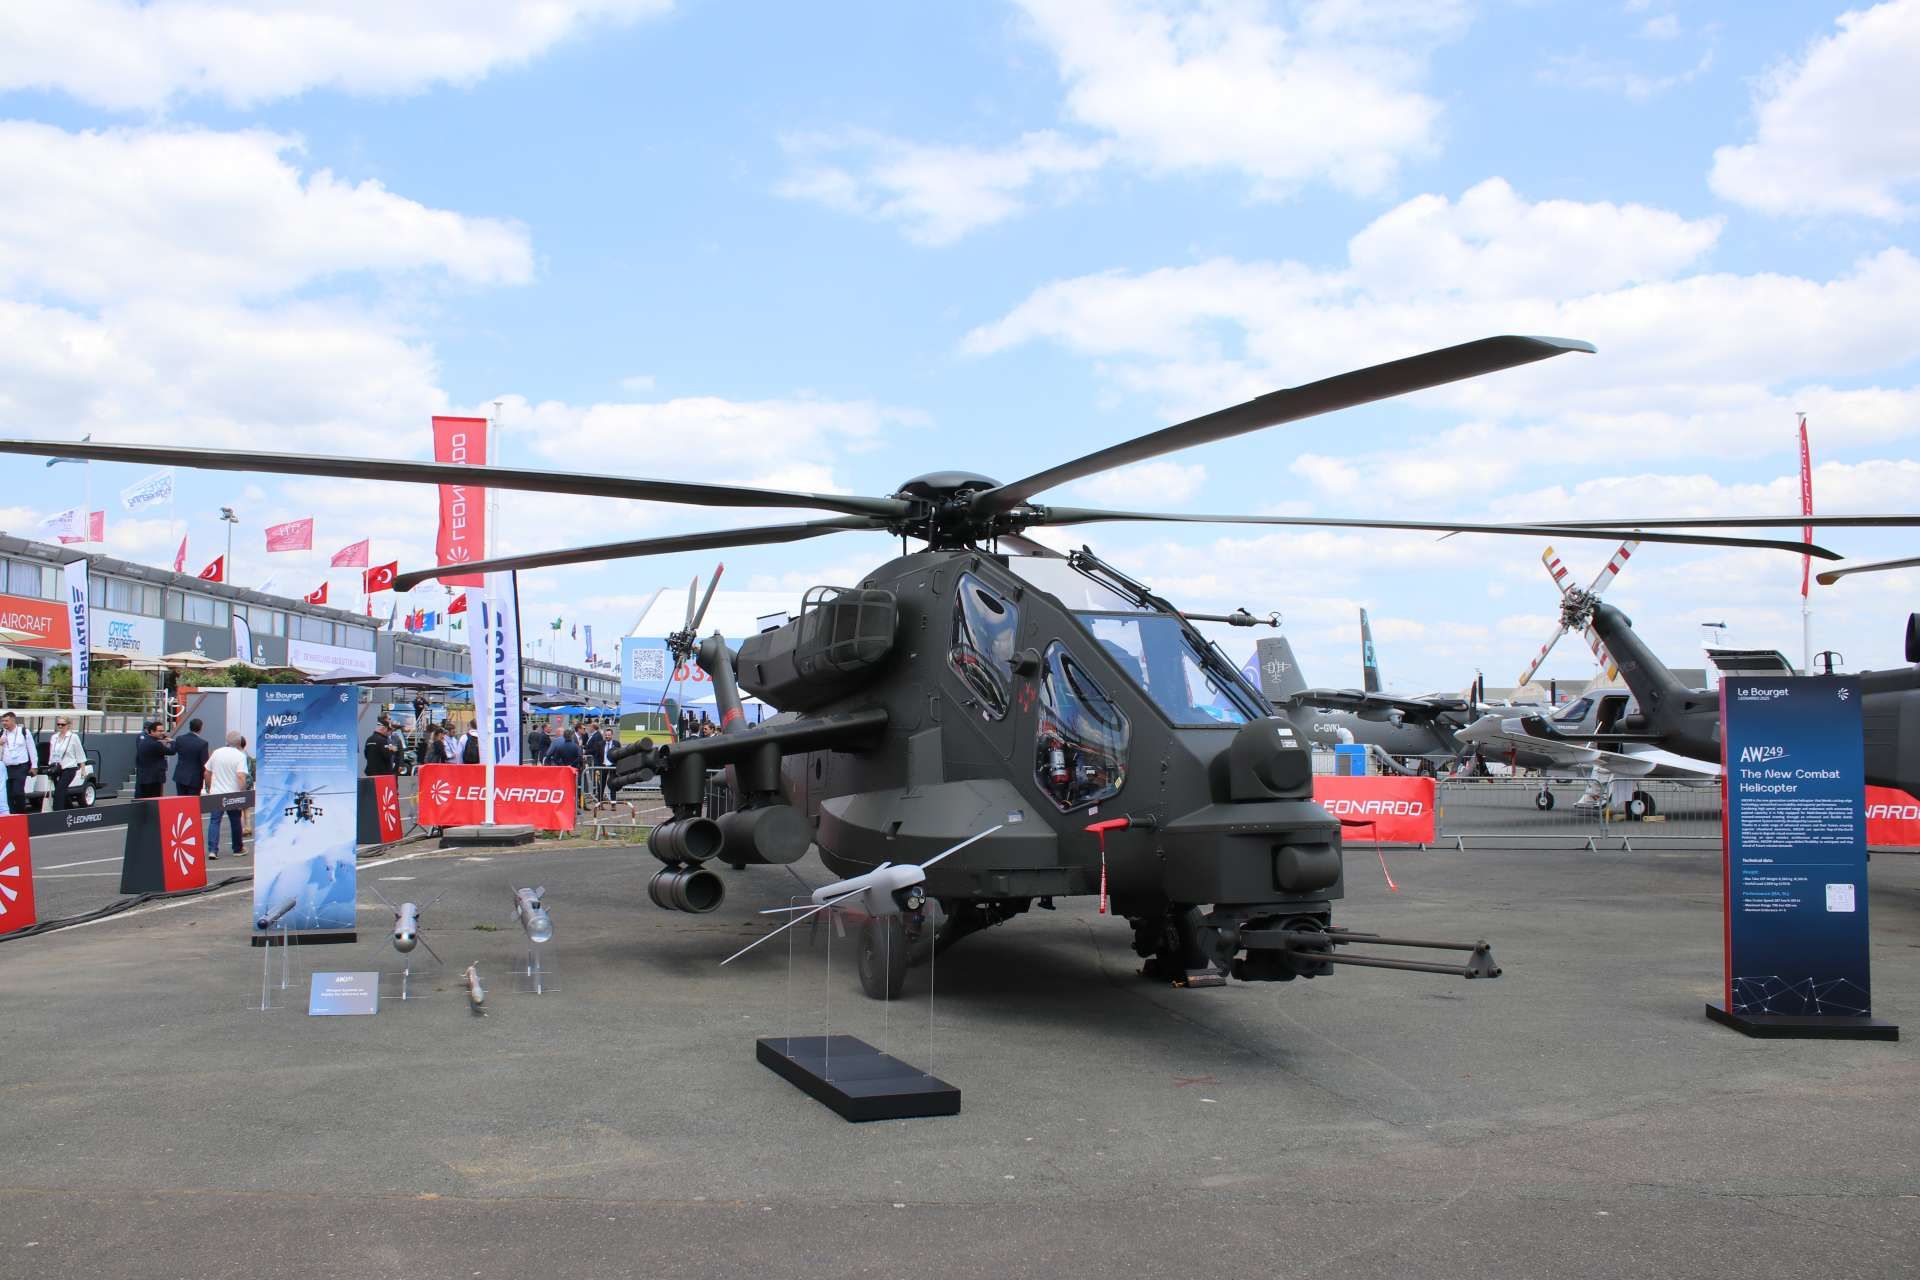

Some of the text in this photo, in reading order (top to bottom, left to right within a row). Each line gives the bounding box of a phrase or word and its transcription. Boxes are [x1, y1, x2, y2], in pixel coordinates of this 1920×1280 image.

[0, 612, 53, 632] AIRCRAFT
[74, 603, 88, 671] PILATUS
[276, 692, 304, 700] Bourget
[1737, 688, 1789, 698] Le Bourget
[265, 714, 298, 726] AW249
[264, 733, 298, 741] Delivering
[1740, 746, 1784, 763] AW249
[1740, 769, 1840, 779] The New Combat
[1739, 783, 1798, 794] Helicopter
[1313, 799, 1423, 817] EONARDO
[73, 813, 102, 824] LEONARDO
